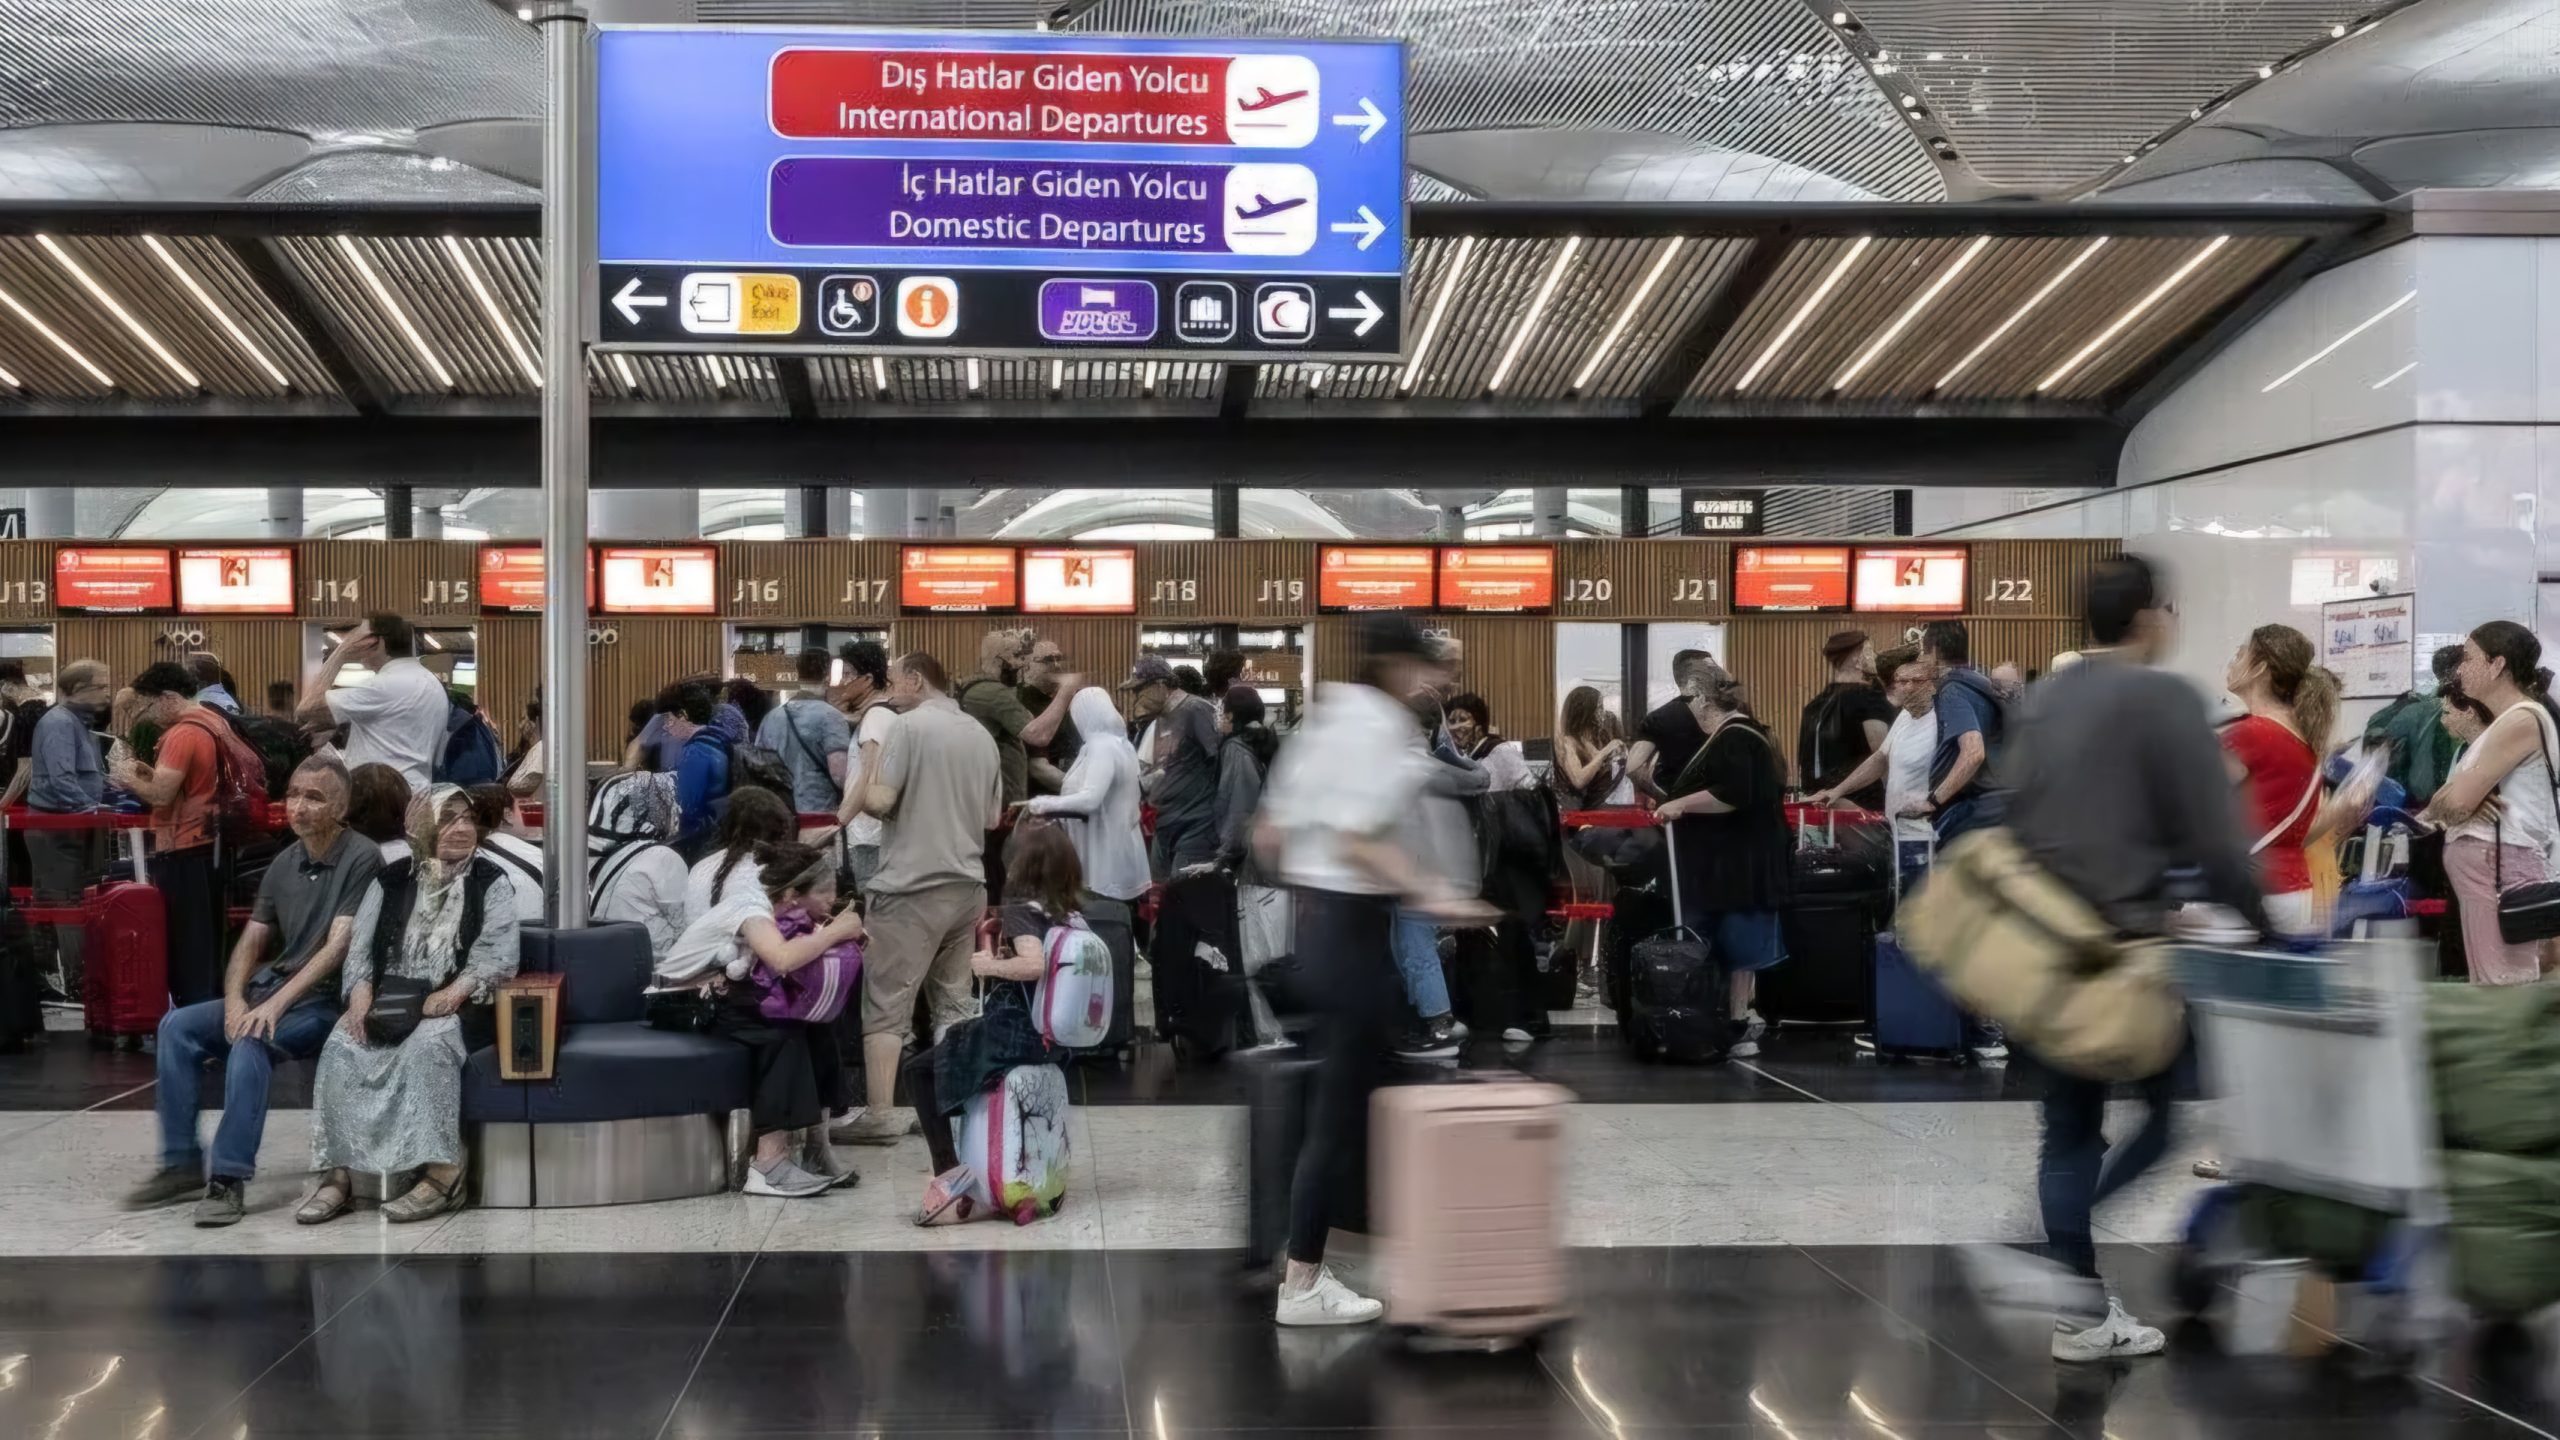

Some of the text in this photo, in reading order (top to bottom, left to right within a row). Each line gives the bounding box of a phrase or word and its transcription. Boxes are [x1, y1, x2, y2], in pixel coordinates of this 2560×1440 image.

[882, 60, 1209, 95] Dış Hatlar Giden Yolcu
[839, 102, 1208, 139] International Departures
[935, 167, 1025, 196] Hatlar
[1031, 169, 1120, 198] Giden
[1128, 171, 1207, 201] Yolcu
[889, 210, 1206, 247] Domestic Departures
[0, 581, 46, 603] J13
[312, 579, 359, 602] J14
[422, 580, 469, 603] J15
[732, 579, 779, 602] J16
[841, 580, 889, 602] J17
[1150, 580, 1197, 602] J18
[1257, 580, 1304, 602] J19
[1564, 579, 1613, 602] J20
[1672, 579, 1718, 602] J21
[1985, 579, 2033, 602] J22
